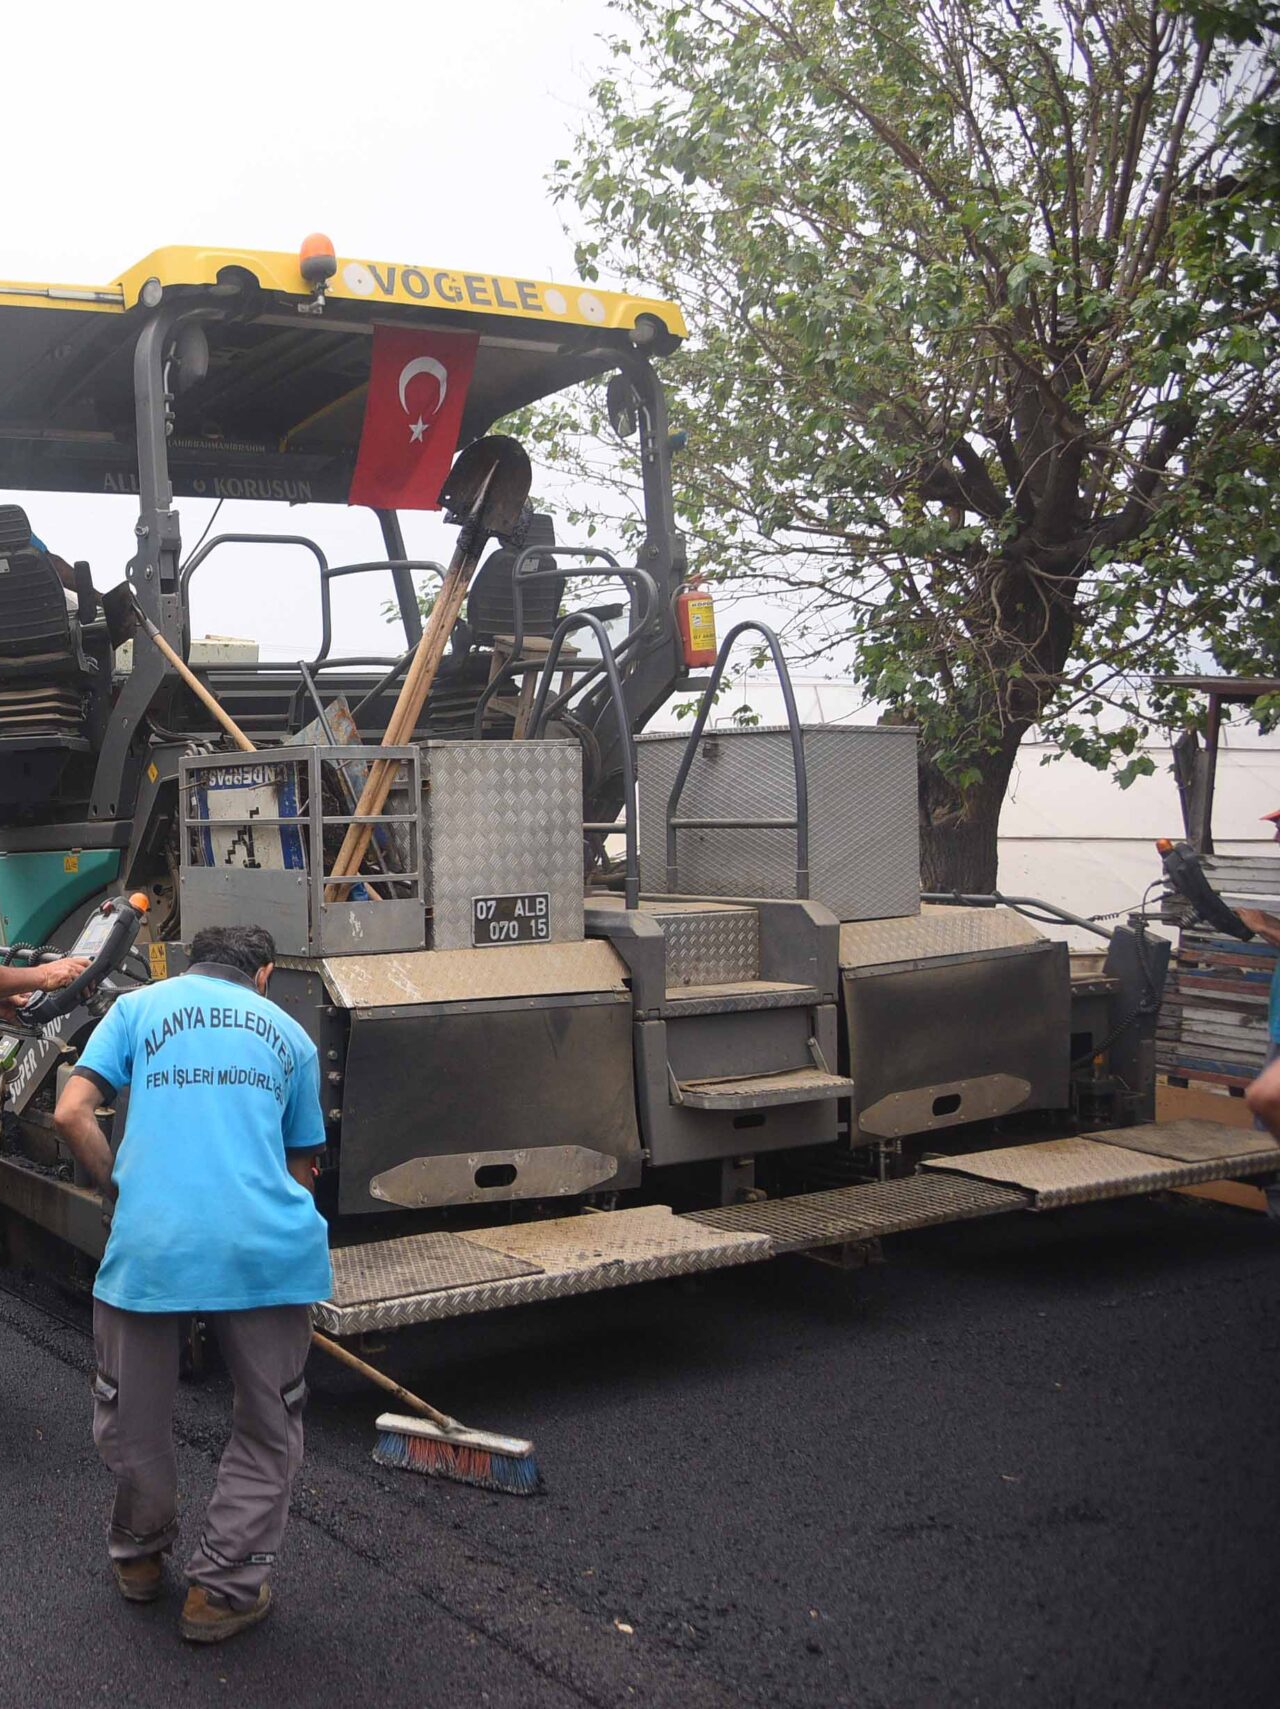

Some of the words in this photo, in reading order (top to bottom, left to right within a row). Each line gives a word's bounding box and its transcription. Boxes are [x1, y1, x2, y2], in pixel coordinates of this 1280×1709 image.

[367, 264, 544, 312] VÖGELE
[103, 472, 141, 492] ALL
[213, 477, 313, 499] KORUSUN
[476, 900, 497, 920] 07
[514, 897, 547, 918] ALB
[489, 920, 519, 940] 070
[530, 918, 547, 937] 15
[144, 1006, 206, 1066] ALANYA
[8, 1048, 38, 1104] SUPER
[146, 1070, 169, 1090] FEN
[172, 1064, 214, 1089] İŞLERİ
